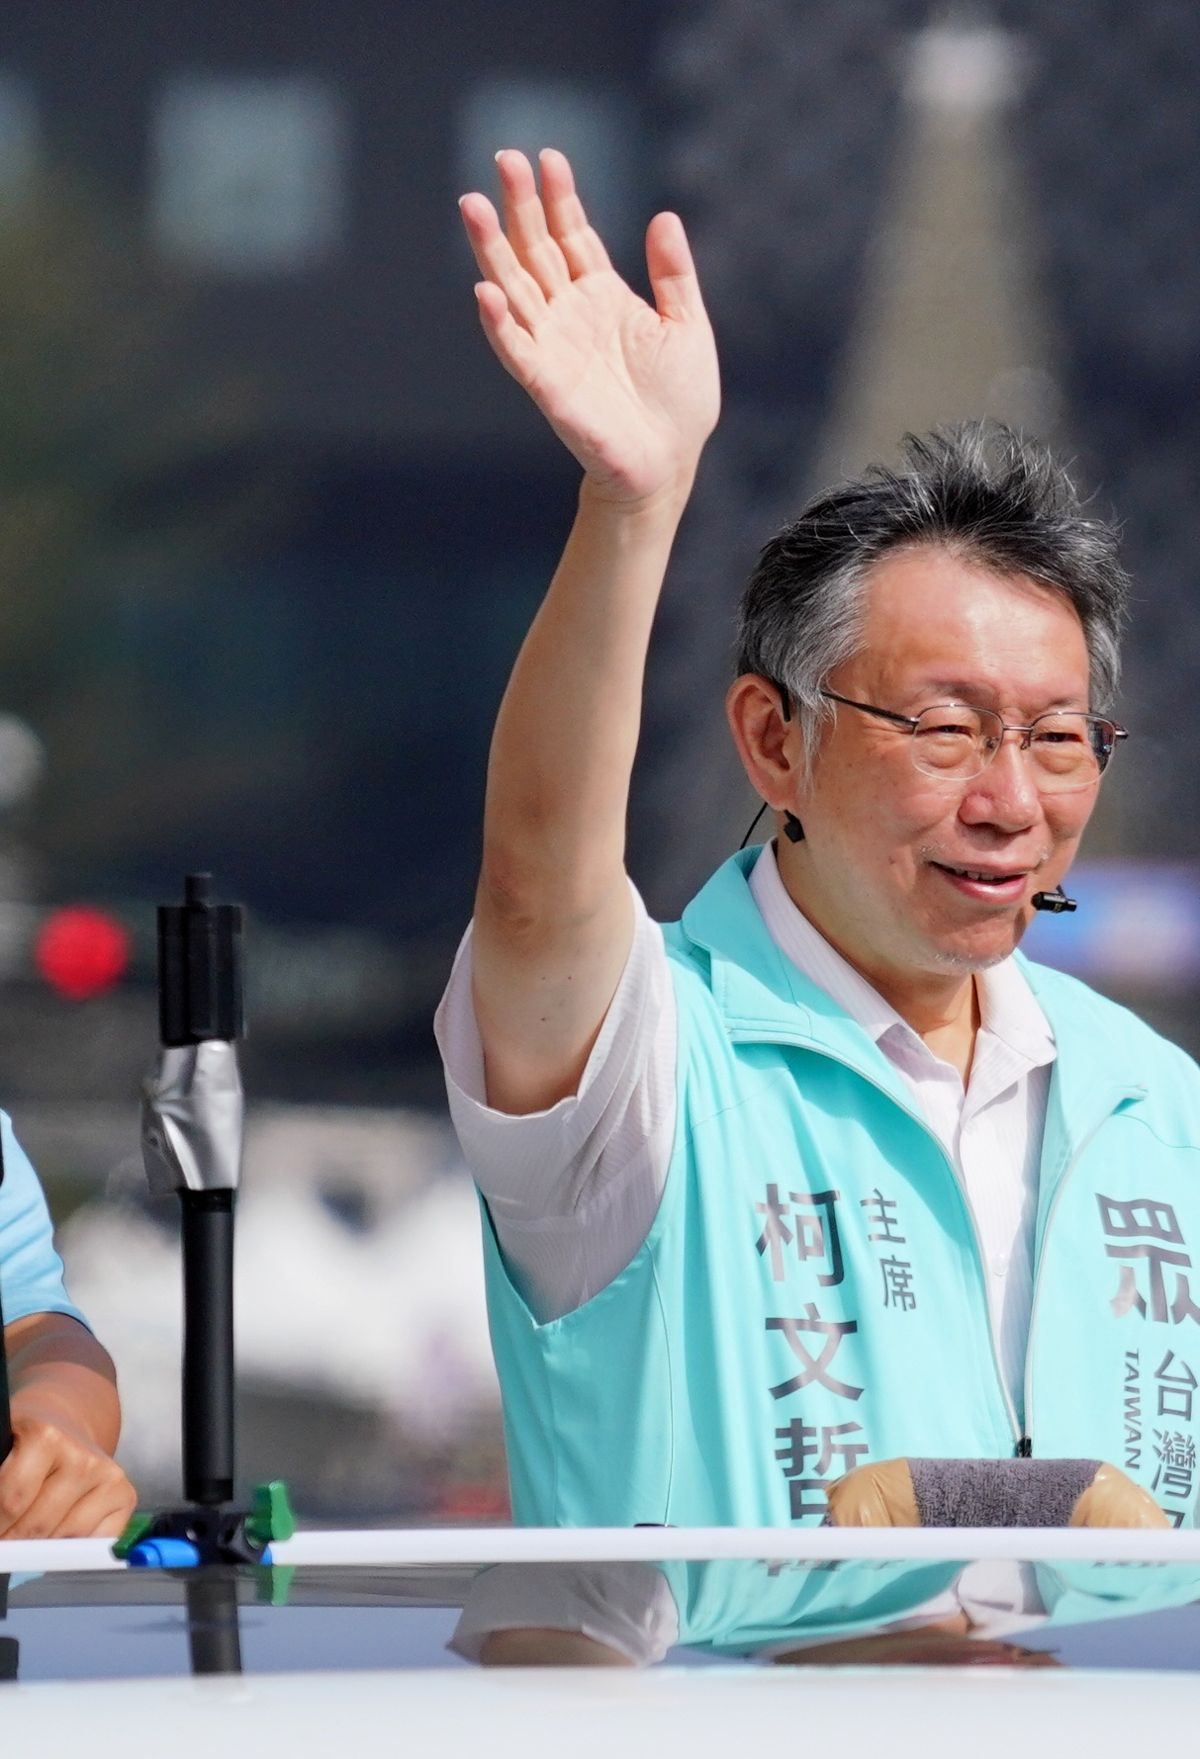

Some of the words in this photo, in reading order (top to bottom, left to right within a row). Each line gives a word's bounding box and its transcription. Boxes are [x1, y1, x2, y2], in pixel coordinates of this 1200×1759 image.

[859, 1188, 917, 1312] 主席
[754, 1183, 869, 1520] 柯文哲
[1123, 1348, 1142, 1470] TAIWAN
[1151, 1349, 1199, 1528] 台灣
